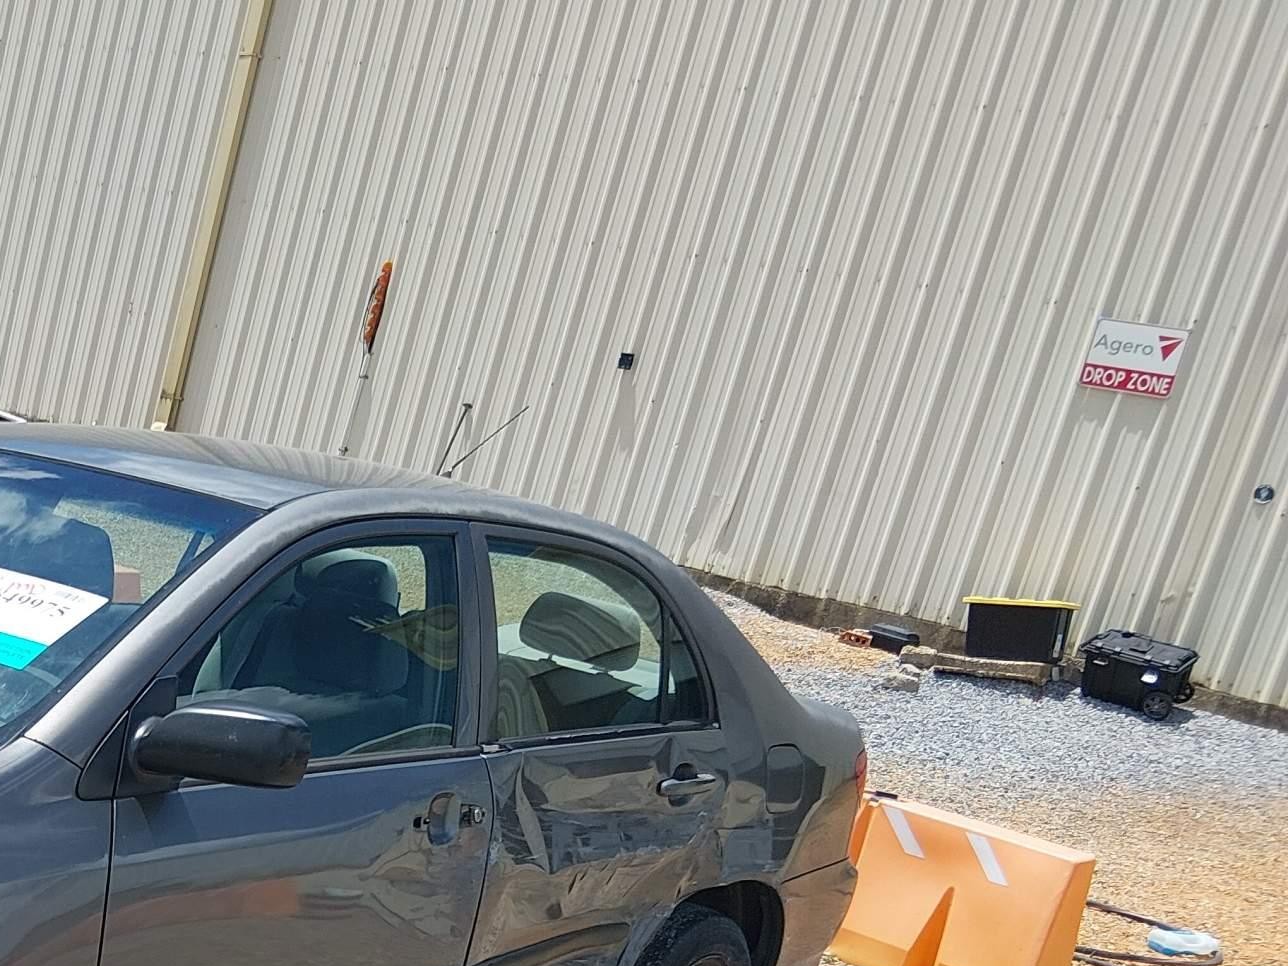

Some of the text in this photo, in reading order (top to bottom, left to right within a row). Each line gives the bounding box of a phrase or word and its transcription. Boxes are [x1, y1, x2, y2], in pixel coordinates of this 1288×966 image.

[1094, 334, 1154, 355] Agero
[1083, 366, 1171, 394] DROP ZONE
